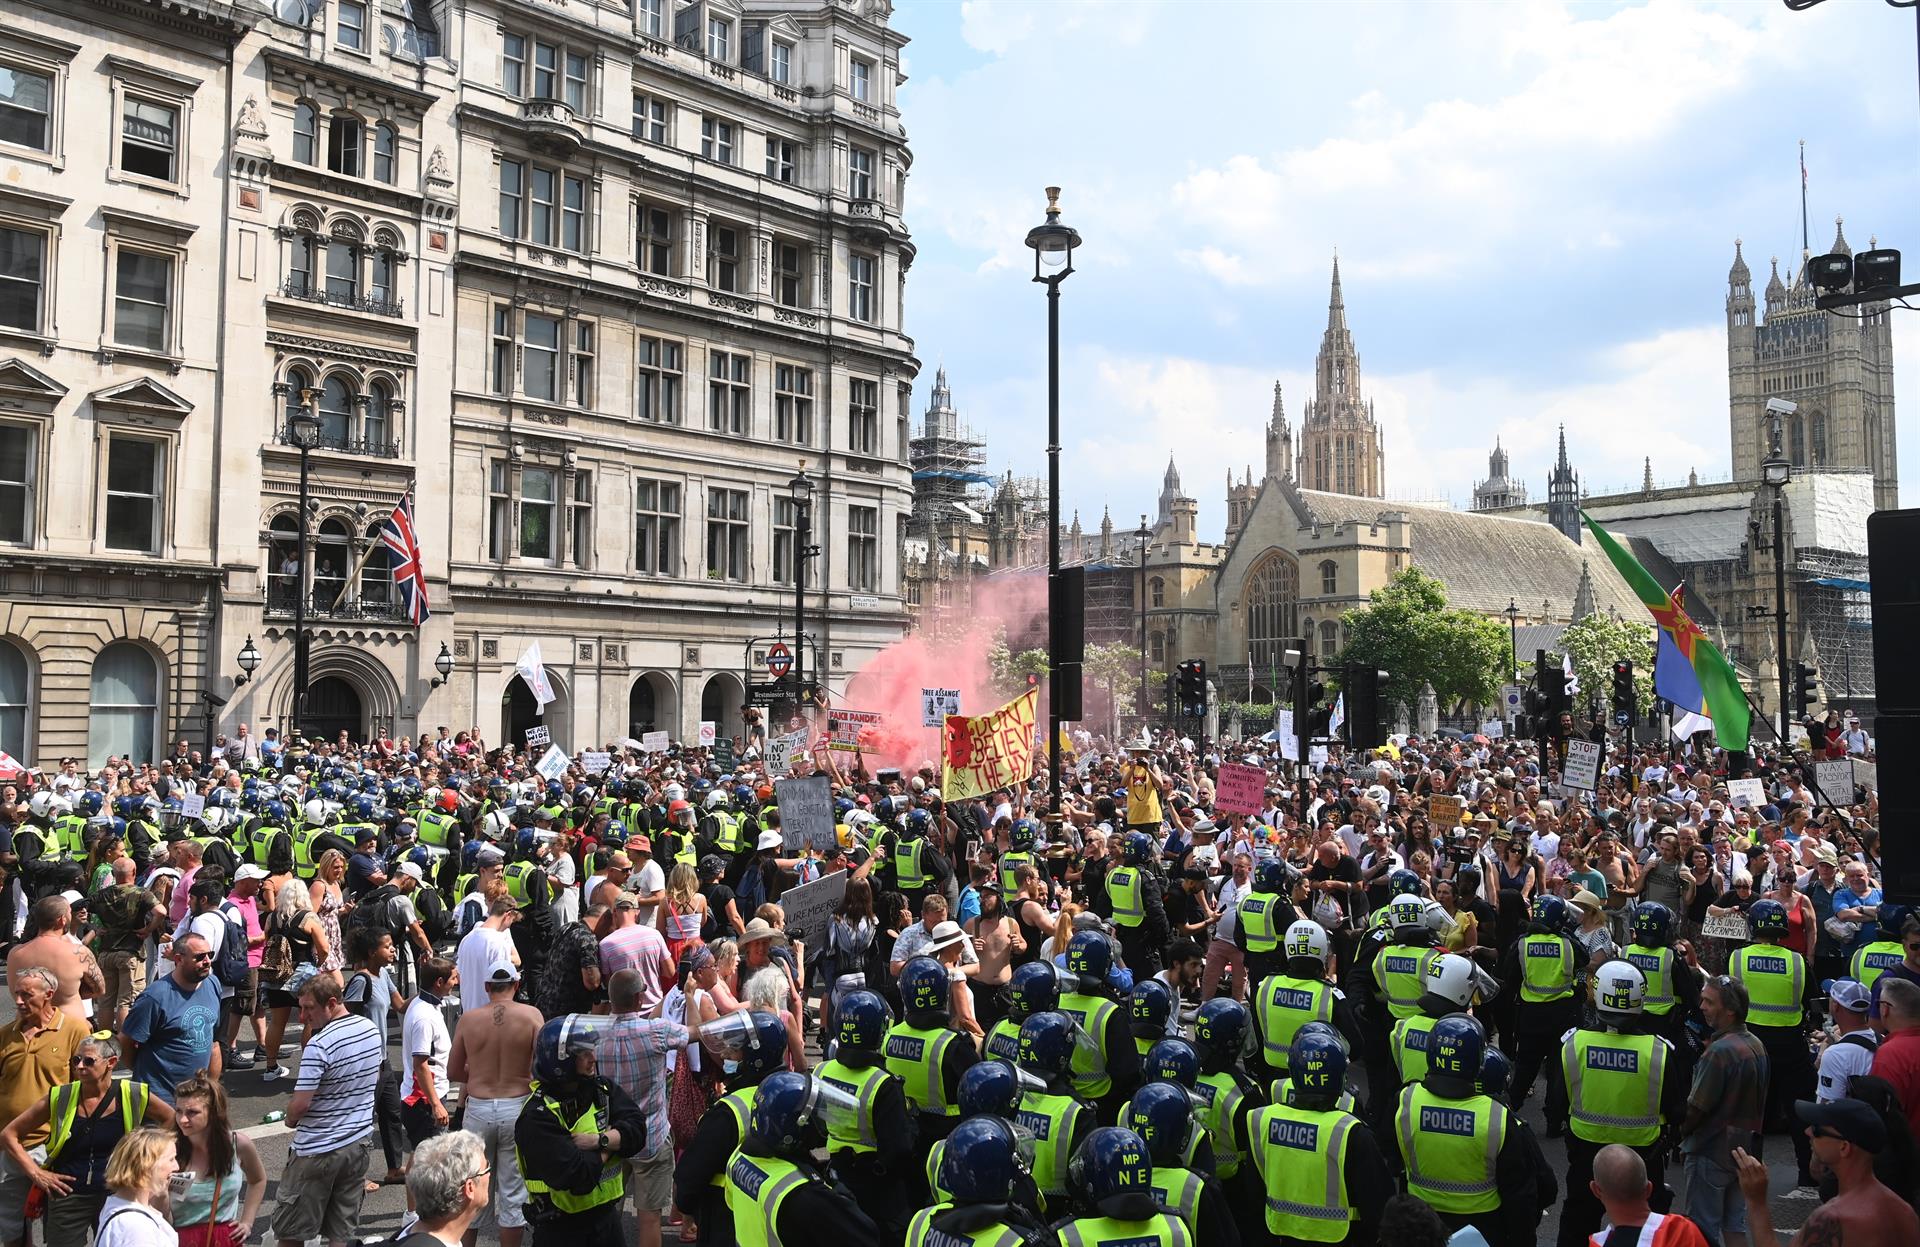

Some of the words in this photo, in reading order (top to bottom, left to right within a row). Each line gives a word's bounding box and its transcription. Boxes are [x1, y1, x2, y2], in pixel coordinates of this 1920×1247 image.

[922, 689, 934, 697] FREE
[935, 690, 959, 698] ASSANGE
[829, 711, 848, 721] FAKE
[526, 728, 537, 736] WE
[537, 725, 548, 734] ARE
[527, 731, 549, 741] WIDE
[531, 738, 548, 746] AWAKE
[1572, 742, 1598, 753] STOP
[771, 743, 785, 753] NO
[764, 753, 781, 762] KIDS
[770, 761, 784, 769] VAX
[1821, 763, 1843, 772] VAX
[968, 759, 1005, 793] THE
[1237, 766, 1266, 776] WEARING
[1817, 771, 1853, 782] PASSPORT
[1226, 772, 1256, 783] ZOMBIES
[1222, 781, 1242, 789] WAKE
[1247, 784, 1259, 792] UP
[1821, 786, 1853, 796] DIGITAL
[1234, 790, 1244, 798] OR
[1215, 797, 1241, 806] COMPLY
[798, 803, 828, 818] GENETIC
[786, 830, 801, 847] NOT
[1016, 832, 1033, 840] U23
[812, 879, 834, 894] PAST
[784, 897, 839, 925] NUREMBERG
[1244, 899, 1264, 912] POLICE
[1390, 904, 1423, 913] 8675
[1399, 913, 1416, 923] CE
[1634, 922, 1658, 930] U23
[1703, 925, 1746, 937] GOVERNMENT
[1297, 934, 1309, 942] MP
[1072, 951, 1083, 959] MP
[1287, 944, 1307, 955] CE
[1528, 944, 1560, 956] POLICE
[1069, 961, 1088, 972] CE
[1386, 958, 1416, 972] POLICE
[1629, 956, 1659, 970] POLICE
[1749, 957, 1785, 972] POLICE
[917, 986, 931, 996] MP
[1012, 991, 1022, 1000] MP
[1615, 988, 1630, 996] MP
[915, 996, 938, 1008] CE
[1275, 990, 1312, 1007] POLICE
[1604, 996, 1627, 1009] NE
[1132, 1008, 1150, 1017] CE
[1197, 1015, 1209, 1024] MP
[843, 1023, 856, 1031] MP
[840, 1032, 861, 1044] CE
[1021, 1038, 1031, 1048] MP
[1406, 1032, 1428, 1049] POLI
[1437, 1035, 1463, 1047] 2979
[888, 1038, 922, 1058] POLICE
[989, 1036, 1019, 1057] POLICE
[1440, 1046, 1456, 1057] MP
[1019, 1048, 1038, 1061] EA
[1302, 1050, 1328, 1059] 2152
[1588, 1050, 1635, 1069] POLICE
[1307, 1061, 1323, 1071] MP
[1435, 1057, 1461, 1071] NE
[1162, 1069, 1177, 1079] MP
[1304, 1074, 1329, 1087] KF
[1474, 1082, 1483, 1093] E
[1135, 1113, 1149, 1125] MP
[1422, 1110, 1472, 1132] POLICE
[1015, 1113, 1048, 1137] OLICE
[1270, 1121, 1315, 1146] POLICE
[1122, 1153, 1140, 1165] MP
[732, 1160, 763, 1195] POLICE
[1118, 1169, 1146, 1186] NE
